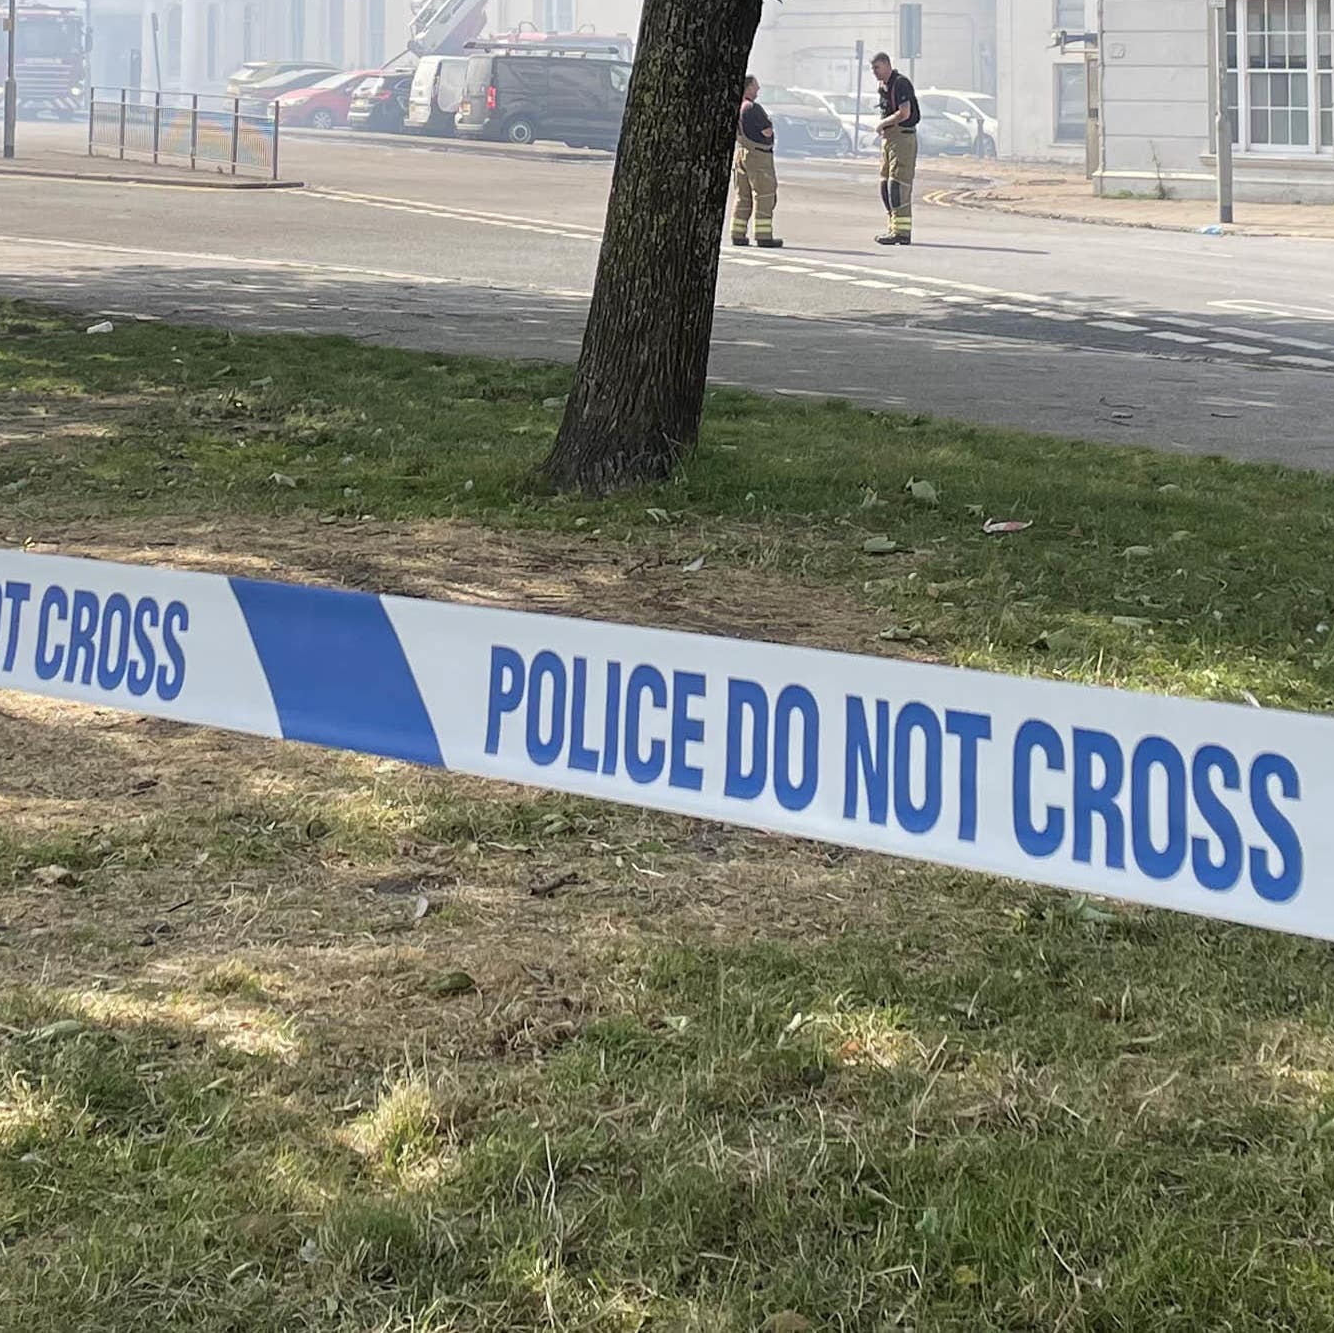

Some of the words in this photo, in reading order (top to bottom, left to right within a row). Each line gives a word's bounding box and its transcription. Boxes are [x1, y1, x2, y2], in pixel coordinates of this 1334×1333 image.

[35, 585, 189, 701] CROSS
[484, 644, 707, 792] POLICE
[723, 677, 820, 812] DO
[843, 694, 993, 843] NOT
[1013, 718, 1303, 904] CROSS
